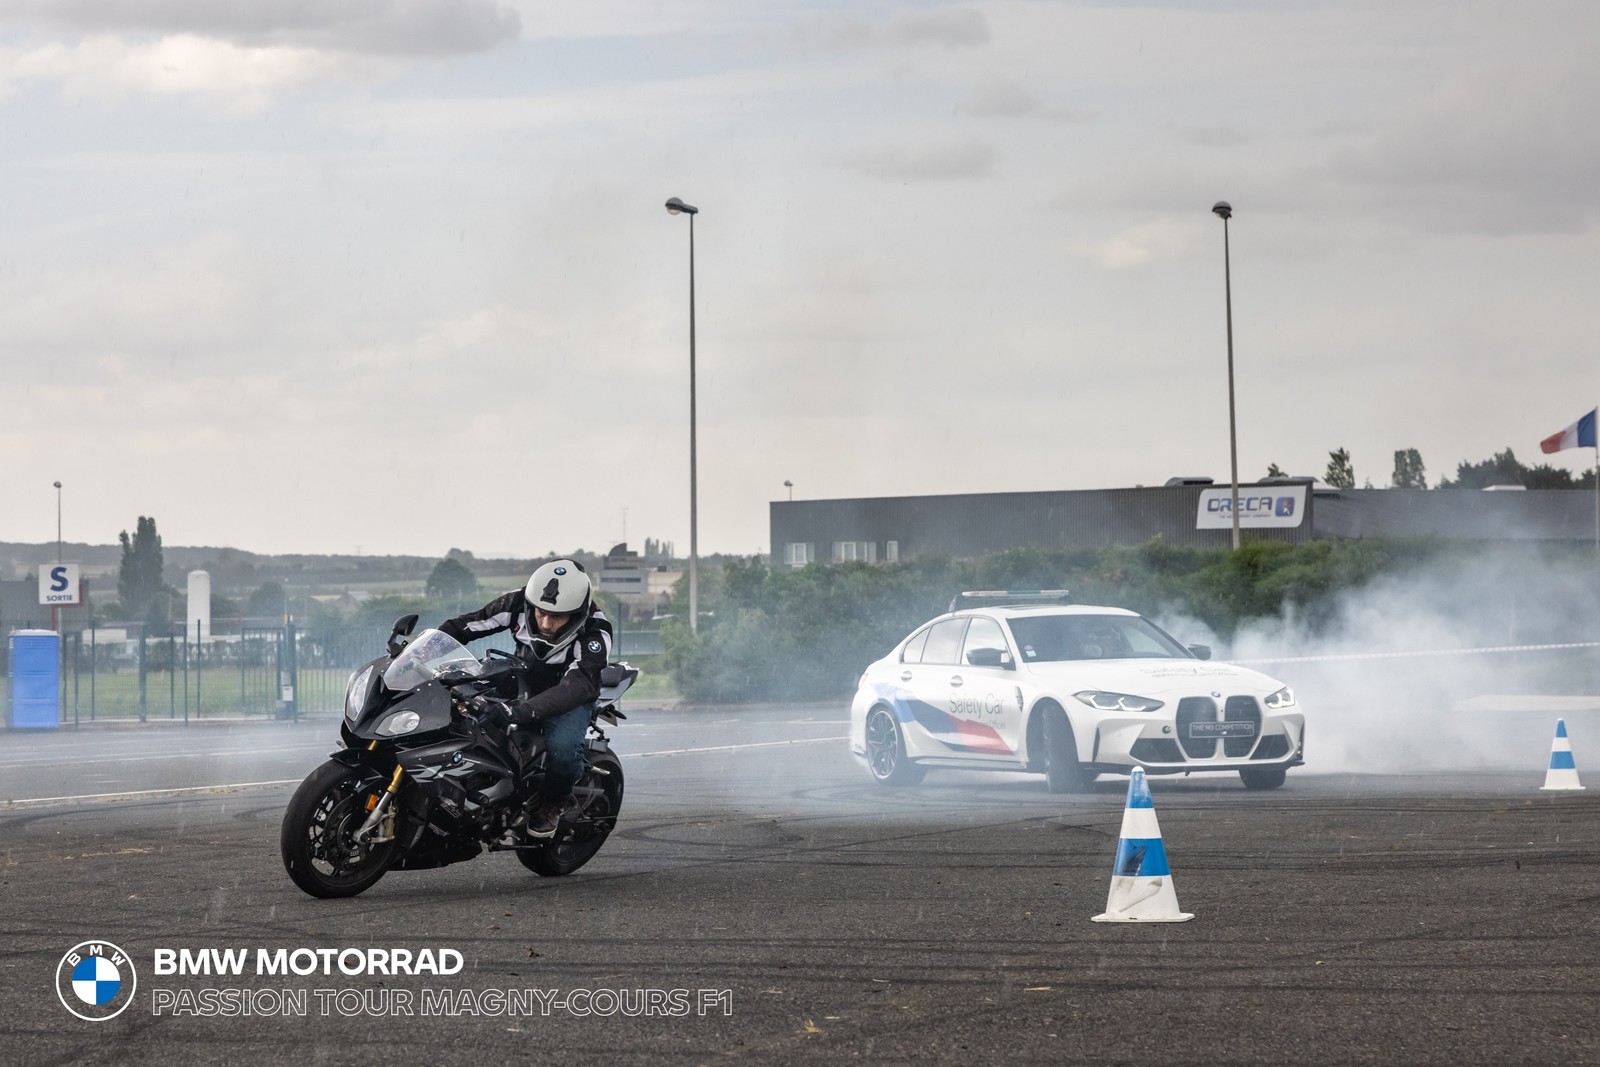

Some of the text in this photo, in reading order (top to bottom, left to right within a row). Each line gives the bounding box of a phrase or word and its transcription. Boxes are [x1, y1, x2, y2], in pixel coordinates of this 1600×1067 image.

[1207, 497, 1273, 512] ORECA
[50, 566, 69, 592] S
[949, 692, 1005, 719] Safety Car
